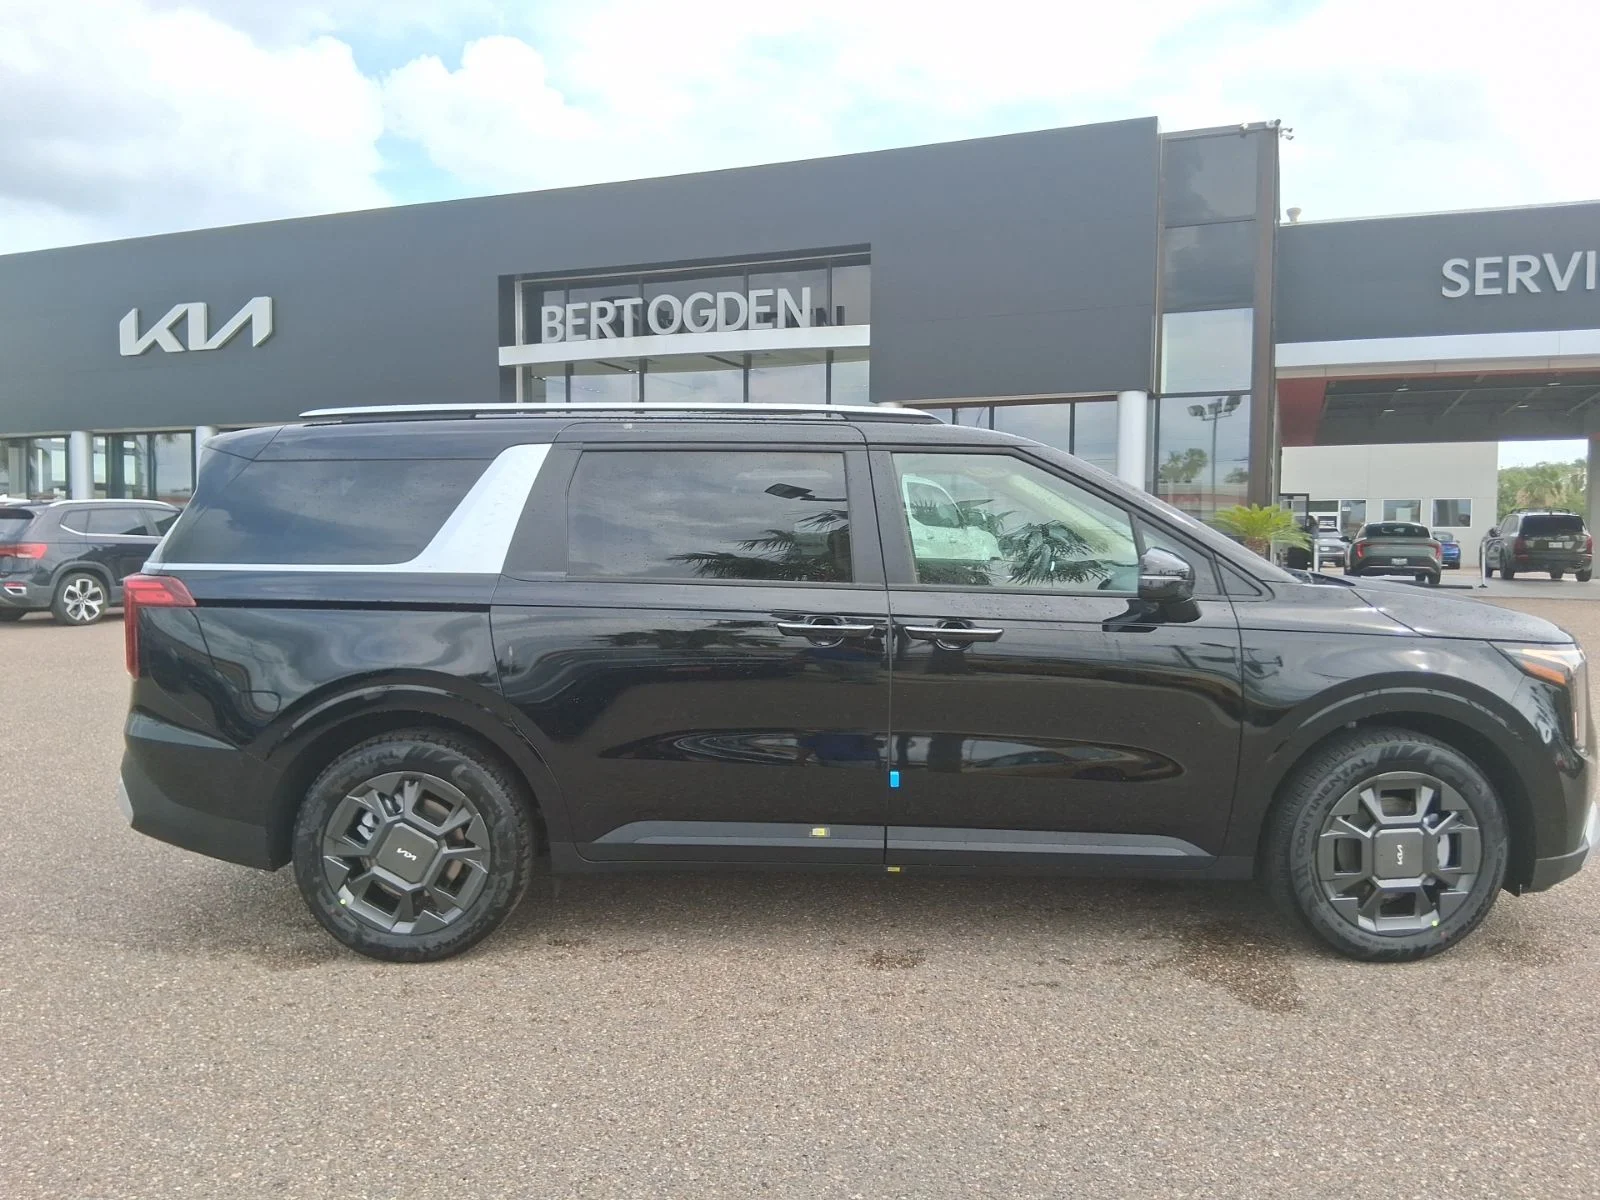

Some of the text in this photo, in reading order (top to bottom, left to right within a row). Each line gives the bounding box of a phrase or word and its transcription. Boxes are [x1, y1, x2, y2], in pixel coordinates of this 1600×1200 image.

[1441, 250, 1597, 298] SERVI
[119, 296, 273, 356] KIA
[541, 286, 811, 344] BERT OGDEN
